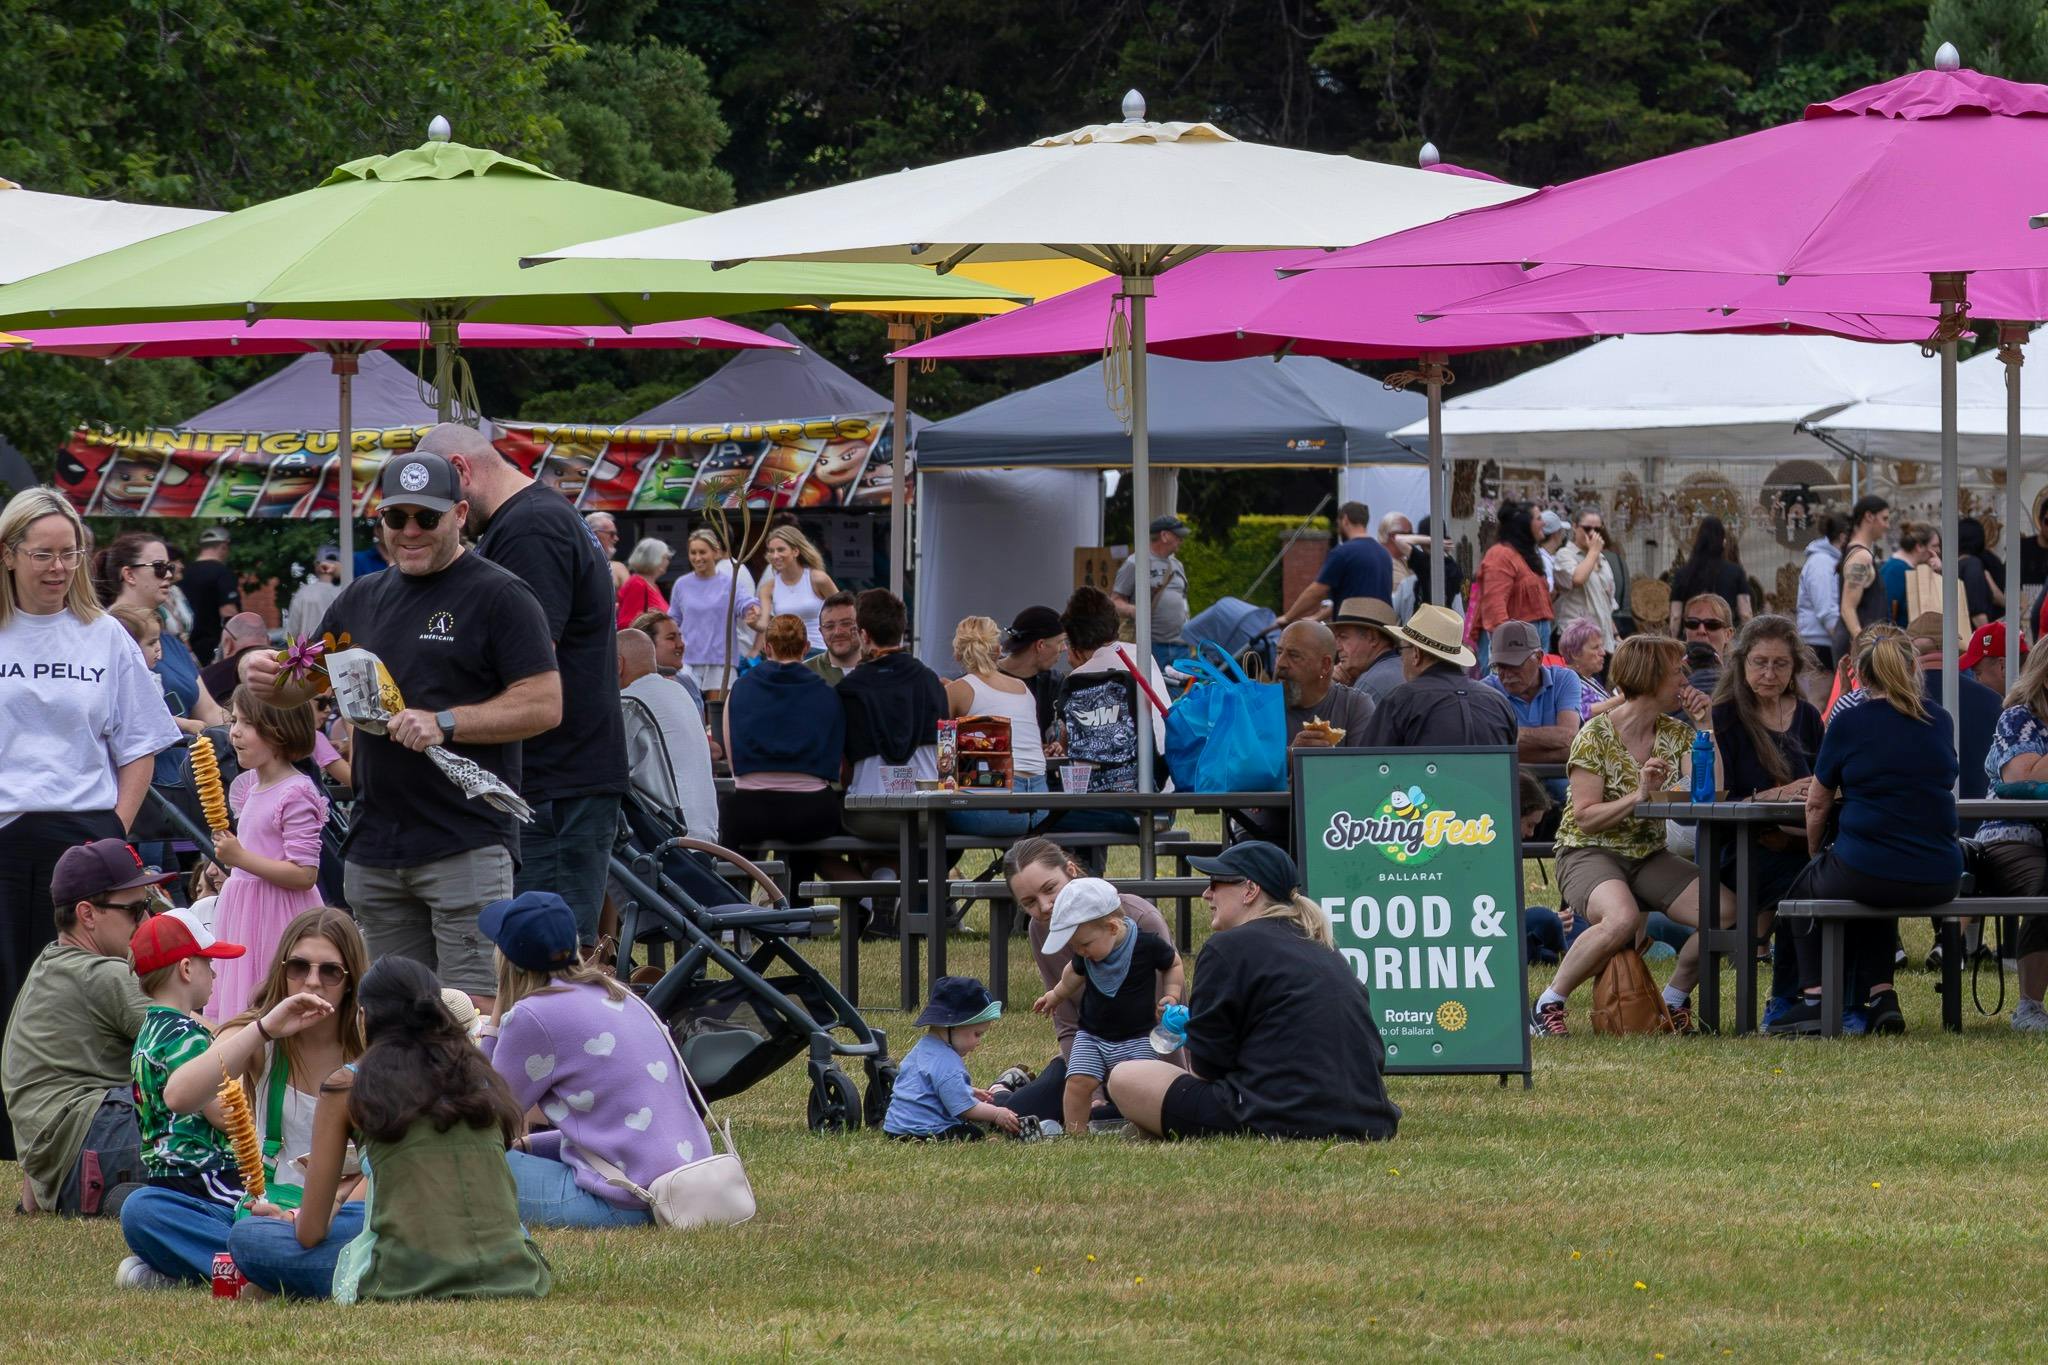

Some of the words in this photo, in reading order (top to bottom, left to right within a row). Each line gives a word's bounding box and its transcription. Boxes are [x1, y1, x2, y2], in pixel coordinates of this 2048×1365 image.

[85, 425, 436, 454] MINIFIGURE
[532, 418, 871, 443] MINIFIGURES
[33, 663, 106, 683] PELLY
[1323, 811, 1496, 856] SpringFest
[1378, 872, 1444, 882] BALLARAT
[1320, 894, 1452, 939] FOOD
[1470, 894, 1508, 938] &
[1385, 1009, 1434, 1025] Rotary
[1389, 1026, 1399, 1036] of
[1401, 1026, 1434, 1036] Ballarat
